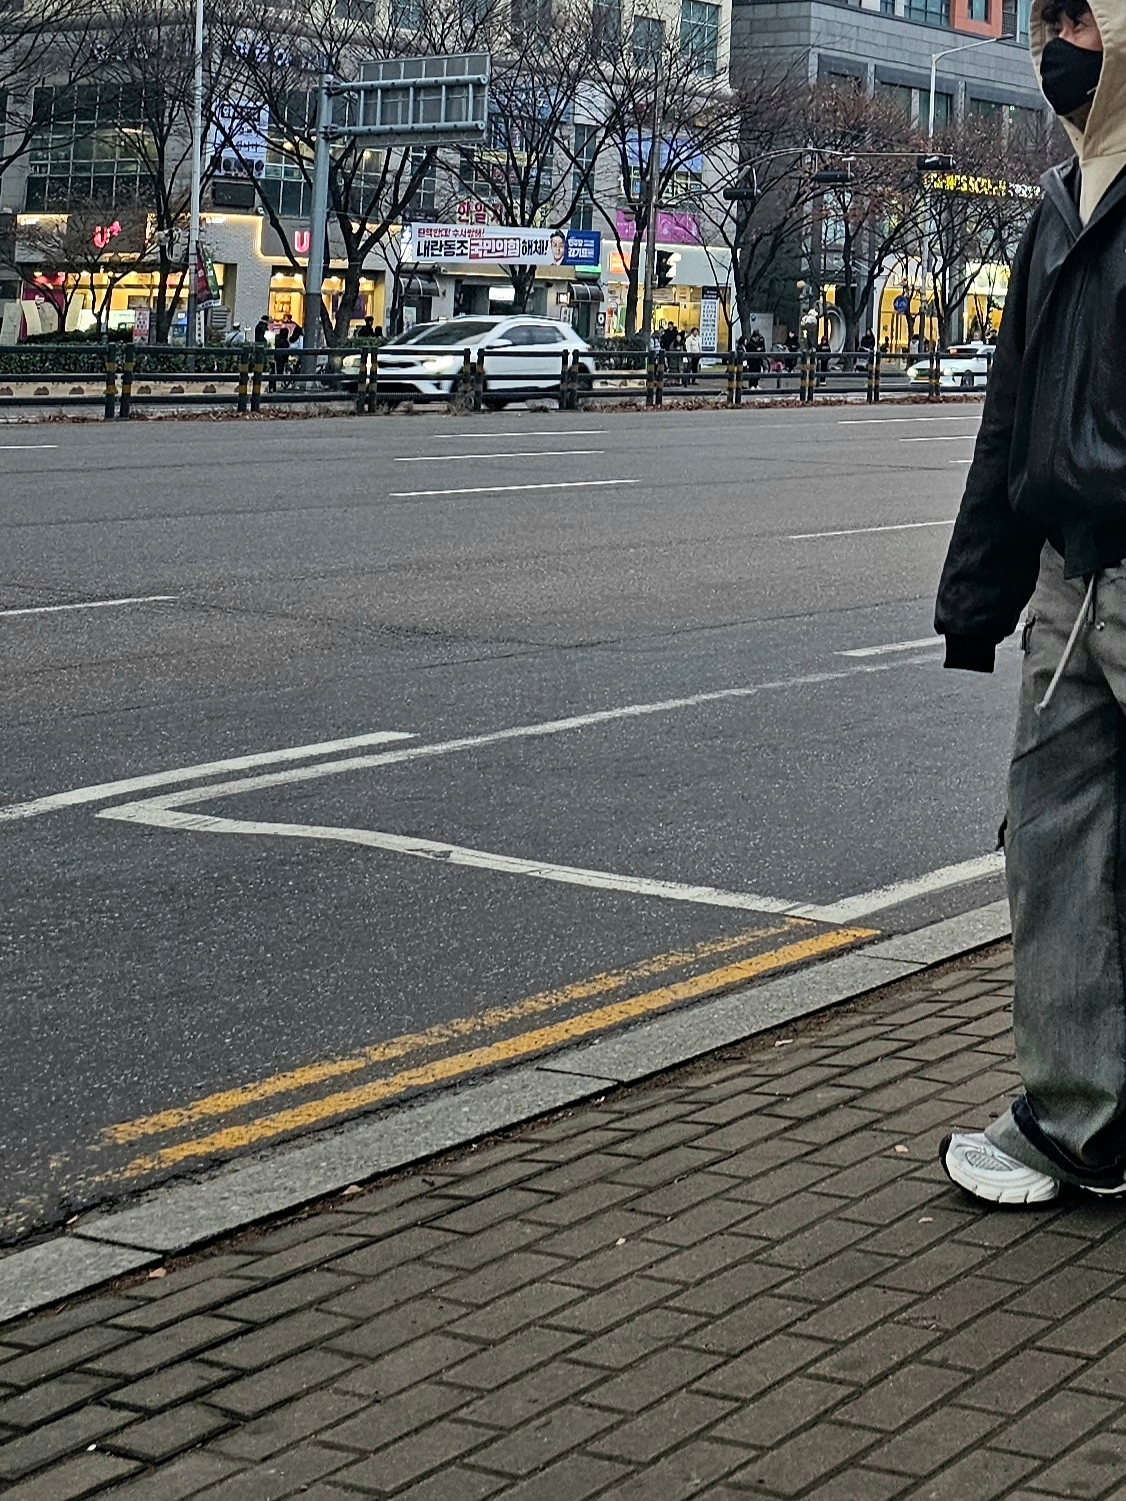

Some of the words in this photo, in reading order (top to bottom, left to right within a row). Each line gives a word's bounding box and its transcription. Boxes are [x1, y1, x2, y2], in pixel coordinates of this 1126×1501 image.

[417, 239, 469, 258] 내란동조
[469, 238, 521, 259] 국민의힘
[521, 239, 549, 256] 해체!
